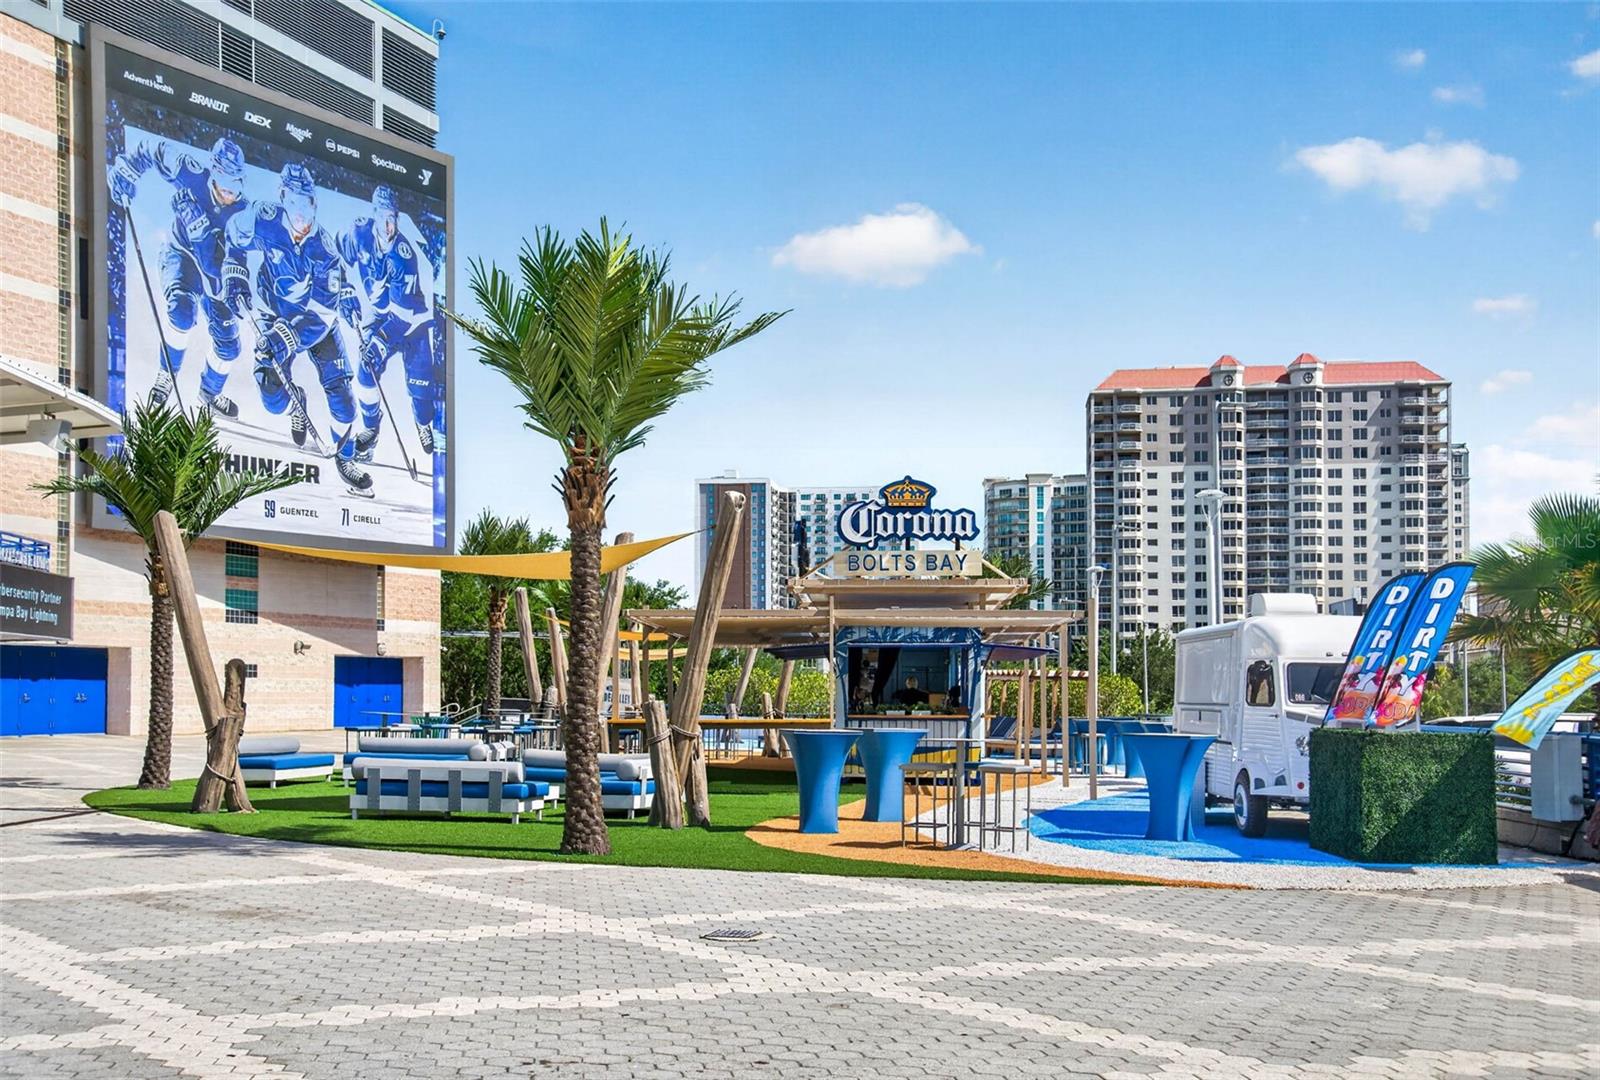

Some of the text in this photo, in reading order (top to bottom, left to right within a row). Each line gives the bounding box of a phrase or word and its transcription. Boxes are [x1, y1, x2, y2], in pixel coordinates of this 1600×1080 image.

[124, 71, 174, 95] AdventHealth
[244, 111, 272, 129] DEX
[336, 144, 360, 159] PEPSI
[371, 154, 406, 174] Spectrum
[264, 499, 319, 518] 59 GUENTZEL
[341, 507, 381, 527] 71 CIRELLI
[840, 500, 977, 547] Corona
[848, 554, 968, 571] BOLTS BAY
[0, 582, 62, 605] bersecurity Partner
[16, 605, 29, 622] Bay
[30, 606, 58, 626] Lightning
[1354, 585, 1410, 692] DIRTY
[1399, 577, 1455, 697] DIRTY
